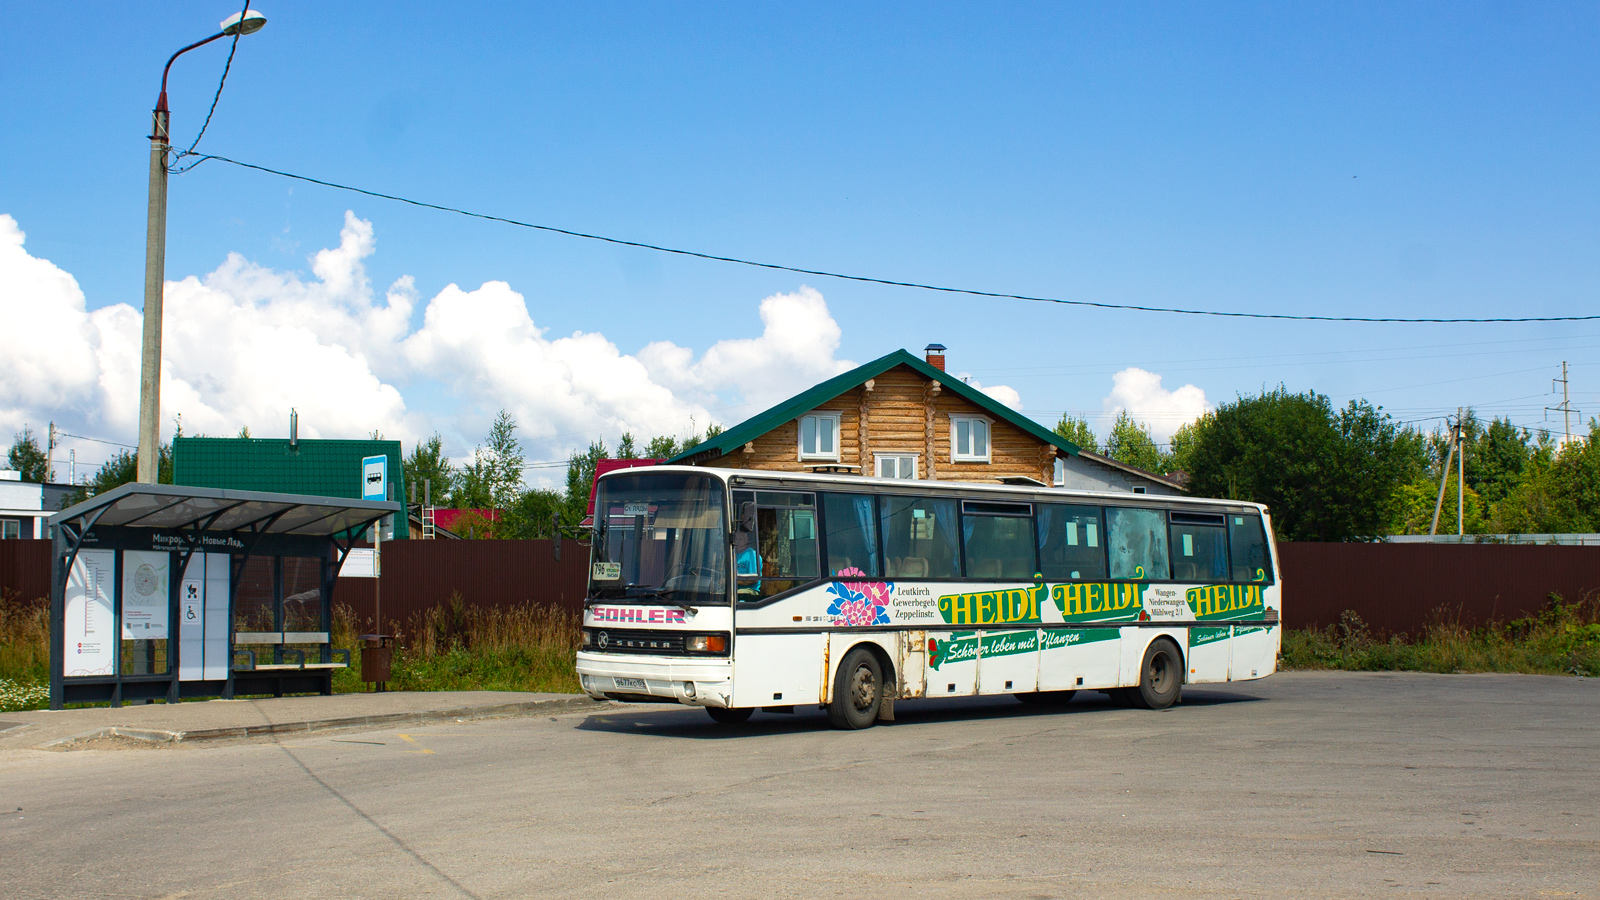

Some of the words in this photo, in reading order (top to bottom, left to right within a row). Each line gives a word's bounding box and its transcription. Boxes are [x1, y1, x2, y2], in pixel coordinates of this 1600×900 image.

[202, 536, 226, 545] Новые
[897, 587, 930, 596] Leutkirch
[1052, 566, 1145, 616] HEIDI
[1154, 588, 1177, 598] Wangen-
[1186, 568, 1265, 617] HEIDI
[892, 598, 937, 609] Gewerbegeb.
[939, 573, 1044, 624] HEIDI
[1148, 598, 1186, 607] Niederwangen
[593, 607, 687, 624] SOHLER
[895, 609, 935, 619] Zeppelinstr.
[1150, 608, 1174, 617] Mühlweg
[616, 640, 670, 648] SETRA
[990, 636, 1016, 654] leben
[1017, 636, 1036, 649] mit
